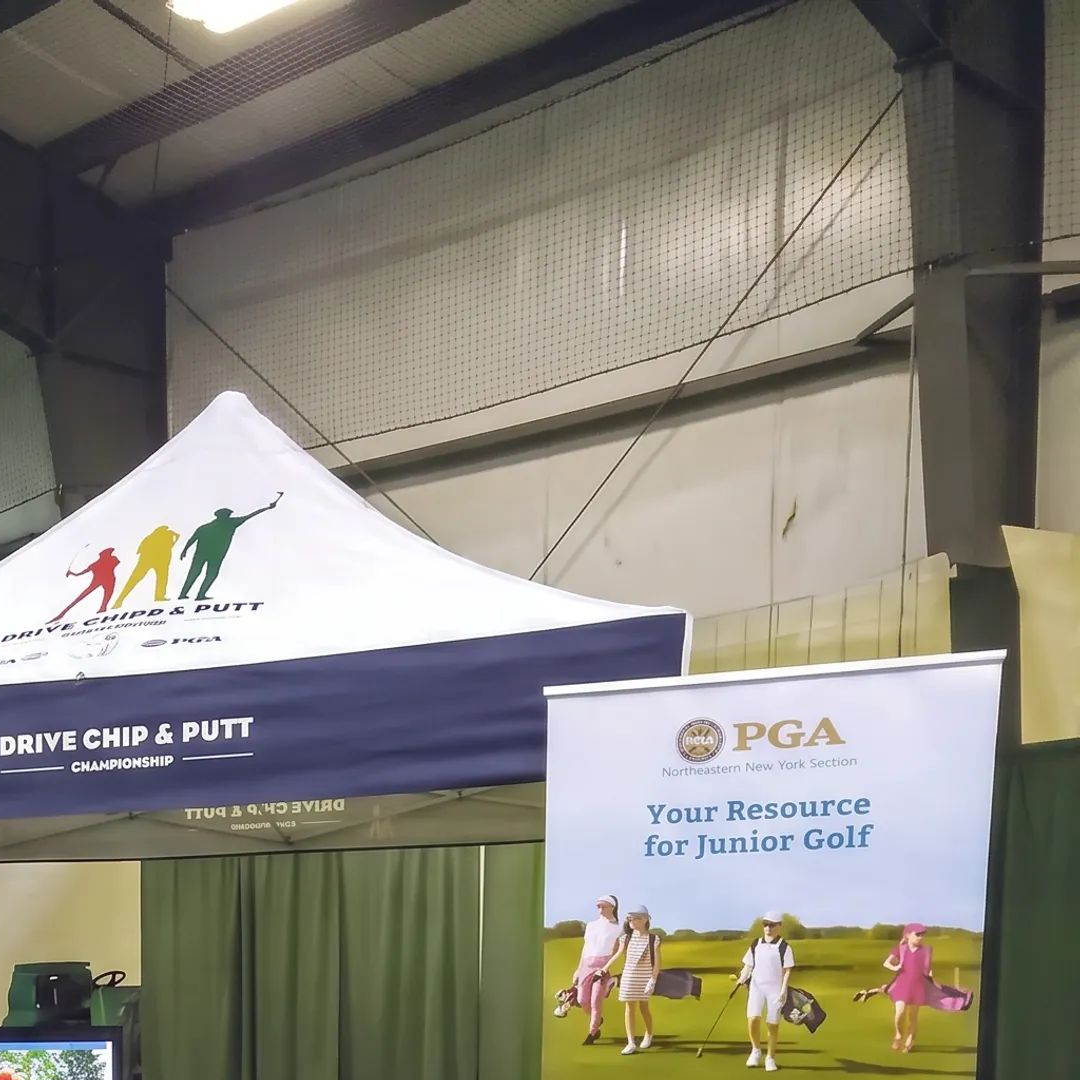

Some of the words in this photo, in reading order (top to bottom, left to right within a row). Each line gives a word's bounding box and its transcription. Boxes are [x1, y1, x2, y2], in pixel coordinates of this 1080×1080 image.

[0, 621, 78, 643] DRIVE
[169, 605, 186, 616] &
[194, 602, 265, 614] PUTT
[0, 730, 78, 757] DRIVE
[82, 724, 149, 751] CHIP
[154, 722, 175, 745] &
[181, 716, 255, 743] PUTT
[731, 716, 847, 752] PGA
[70, 755, 174, 773] CHAMPIONSHIP
[662, 763, 741, 777] Northeastern
[745, 762, 773, 773] New
[778, 758, 806, 770] York
[810, 757, 858, 769] Section
[646, 802, 719, 825] Your
[725, 796, 871, 822] Resource
[643, 834, 689, 857] for
[694, 829, 795, 860] Junior
[802, 823, 875, 851] Golf
